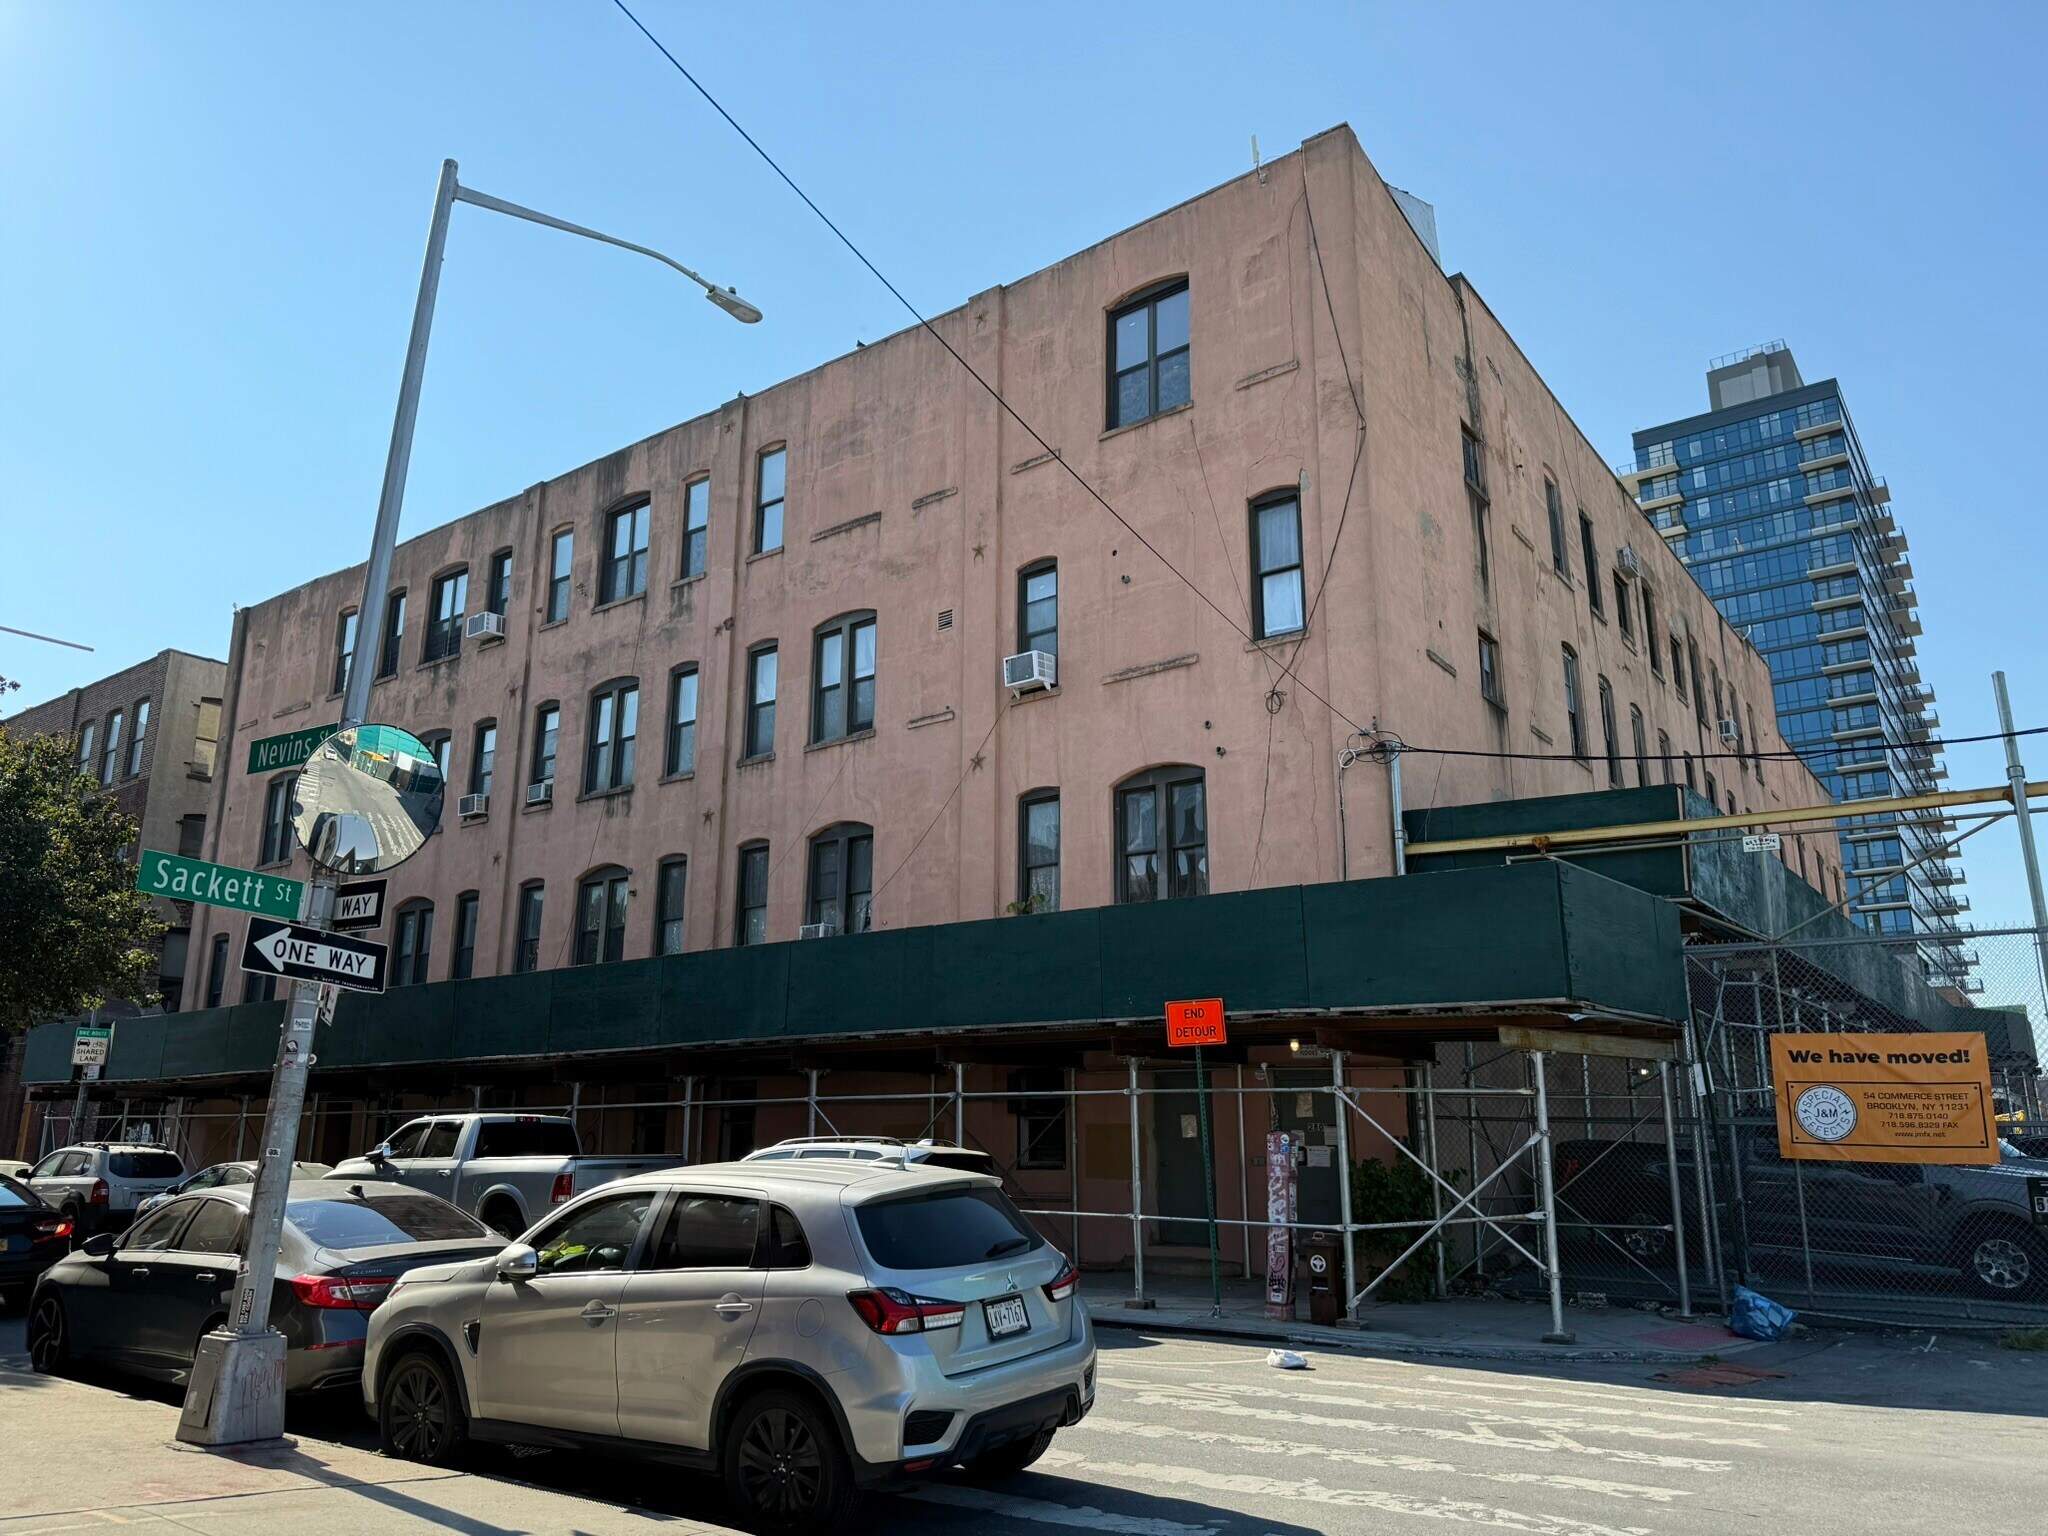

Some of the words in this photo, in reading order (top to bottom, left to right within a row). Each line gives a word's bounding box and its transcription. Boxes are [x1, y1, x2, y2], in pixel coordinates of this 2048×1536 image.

[257, 735, 312, 768] Nevins
[153, 858, 264, 908] Sackett
[275, 883, 292, 903] St
[341, 896, 372, 917] WAY
[273, 939, 318, 965] ONE
[329, 949, 367, 974] WAY
[1184, 1007, 1206, 1020] END
[1175, 1025, 1217, 1038] DETOUR
[76, 1048, 105, 1056] SHARED
[1788, 1049, 1823, 1063] We
[1829, 1049, 1880, 1064] have
[1887, 1049, 1971, 1064] moved!
[1802, 1090, 1847, 1110] SPECIAL
[1863, 1092, 1876, 1100] 54
[1877, 1092, 1933, 1101] COMMERCE
[1934, 1092, 1969, 1101] STREET
[1813, 1108, 1839, 1118] J&M
[1866, 1102, 1919, 1111] BROOKLYN,
[1922, 1103, 1936, 1111] NY
[1938, 1103, 1970, 1111] 11231
[1308, 1123, 1324, 1131] 280
[1801, 1115, 1850, 1136] EFFECTS
[1942, 1121, 1959, 1129] FAX
[350, 1268, 382, 1276] ACCORD
